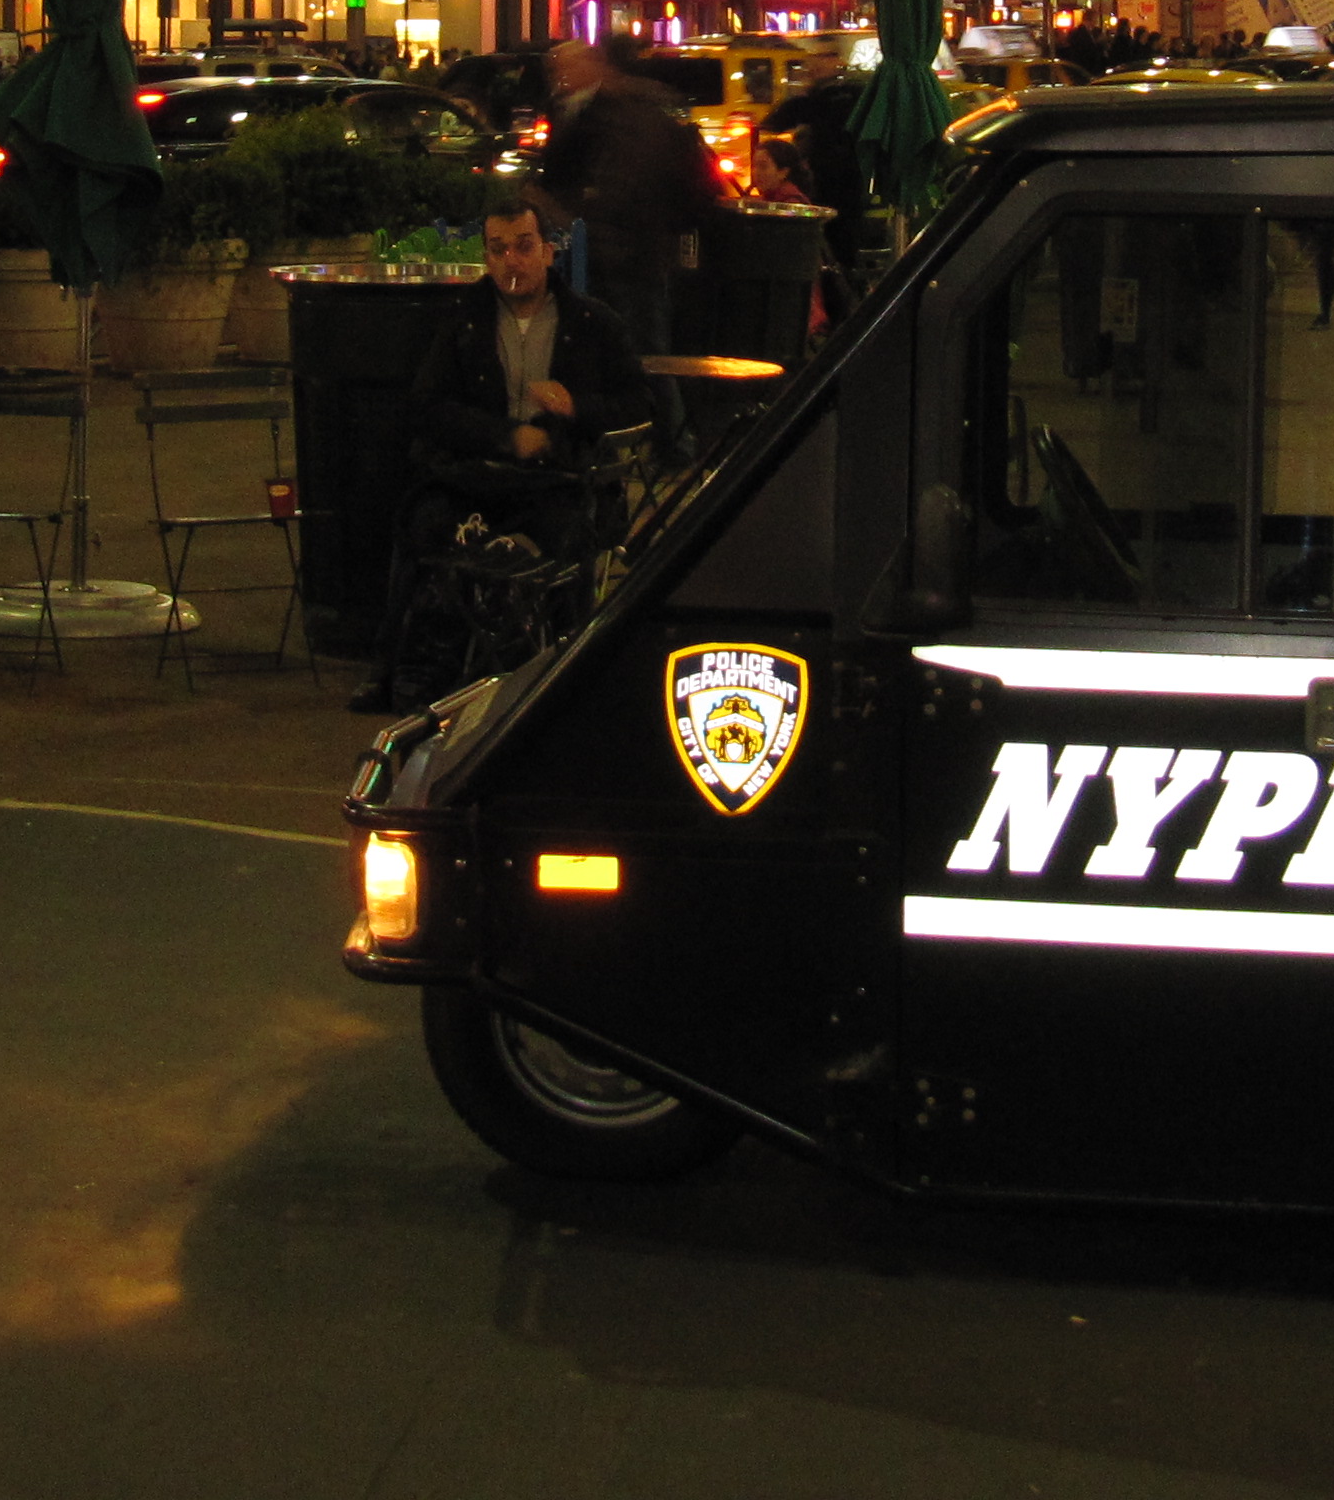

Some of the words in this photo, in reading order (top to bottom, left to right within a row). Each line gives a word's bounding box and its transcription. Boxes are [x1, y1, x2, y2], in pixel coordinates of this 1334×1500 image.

[702, 651, 775, 676] POLICE
[677, 668, 798, 703] DEPARTMENT
[678, 717, 703, 758] CITY
[697, 762, 719, 785] OF
[742, 760, 774, 797] NEW
[770, 712, 797, 757] YORK
